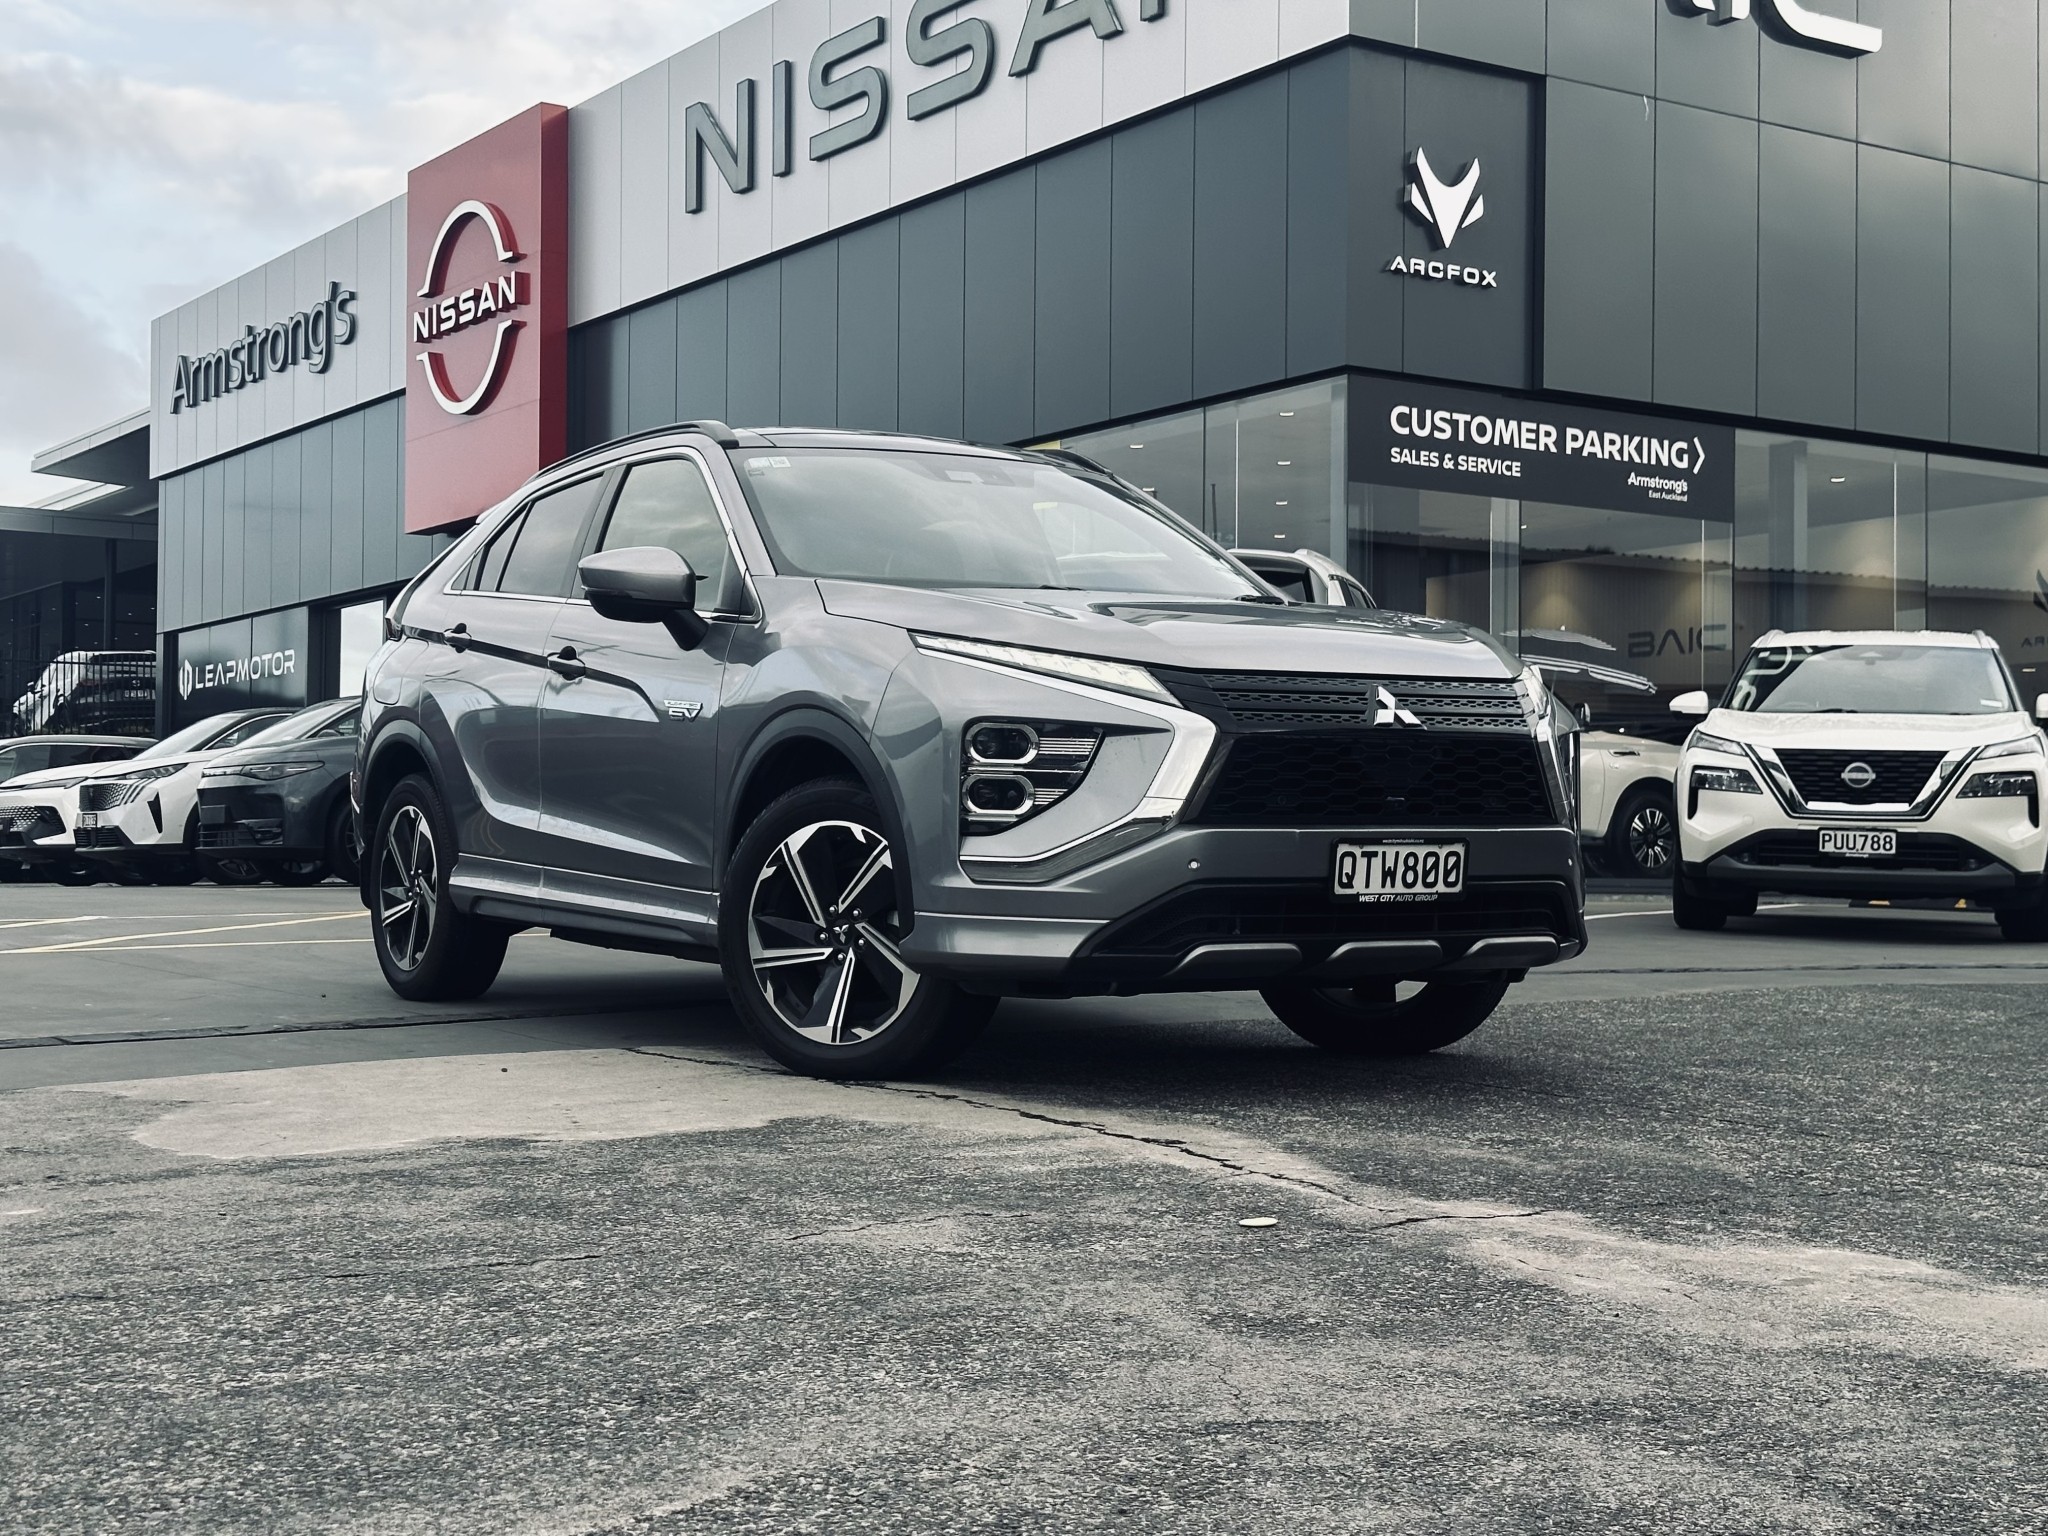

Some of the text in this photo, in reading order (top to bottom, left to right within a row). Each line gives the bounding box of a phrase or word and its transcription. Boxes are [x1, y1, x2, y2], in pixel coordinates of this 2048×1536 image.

[685, 0, 1164, 214] NISSA
[1390, 255, 1497, 288] ARCFOX
[413, 270, 517, 344] NISSAN
[169, 281, 358, 414] Armstrong's
[1389, 405, 1689, 470] CUSTOMER PARKING
[1390, 447, 1522, 478] SALES & SERVICE
[1627, 471, 1688, 494] Armstrong's
[1627, 624, 1727, 658] BAIC
[195, 649, 295, 689] LEAPMOTOR
[1821, 833, 1893, 851] PUU788
[1337, 850, 1461, 889] QTW800
[1359, 894, 1438, 902] WEST CITY AUTO GROUP
